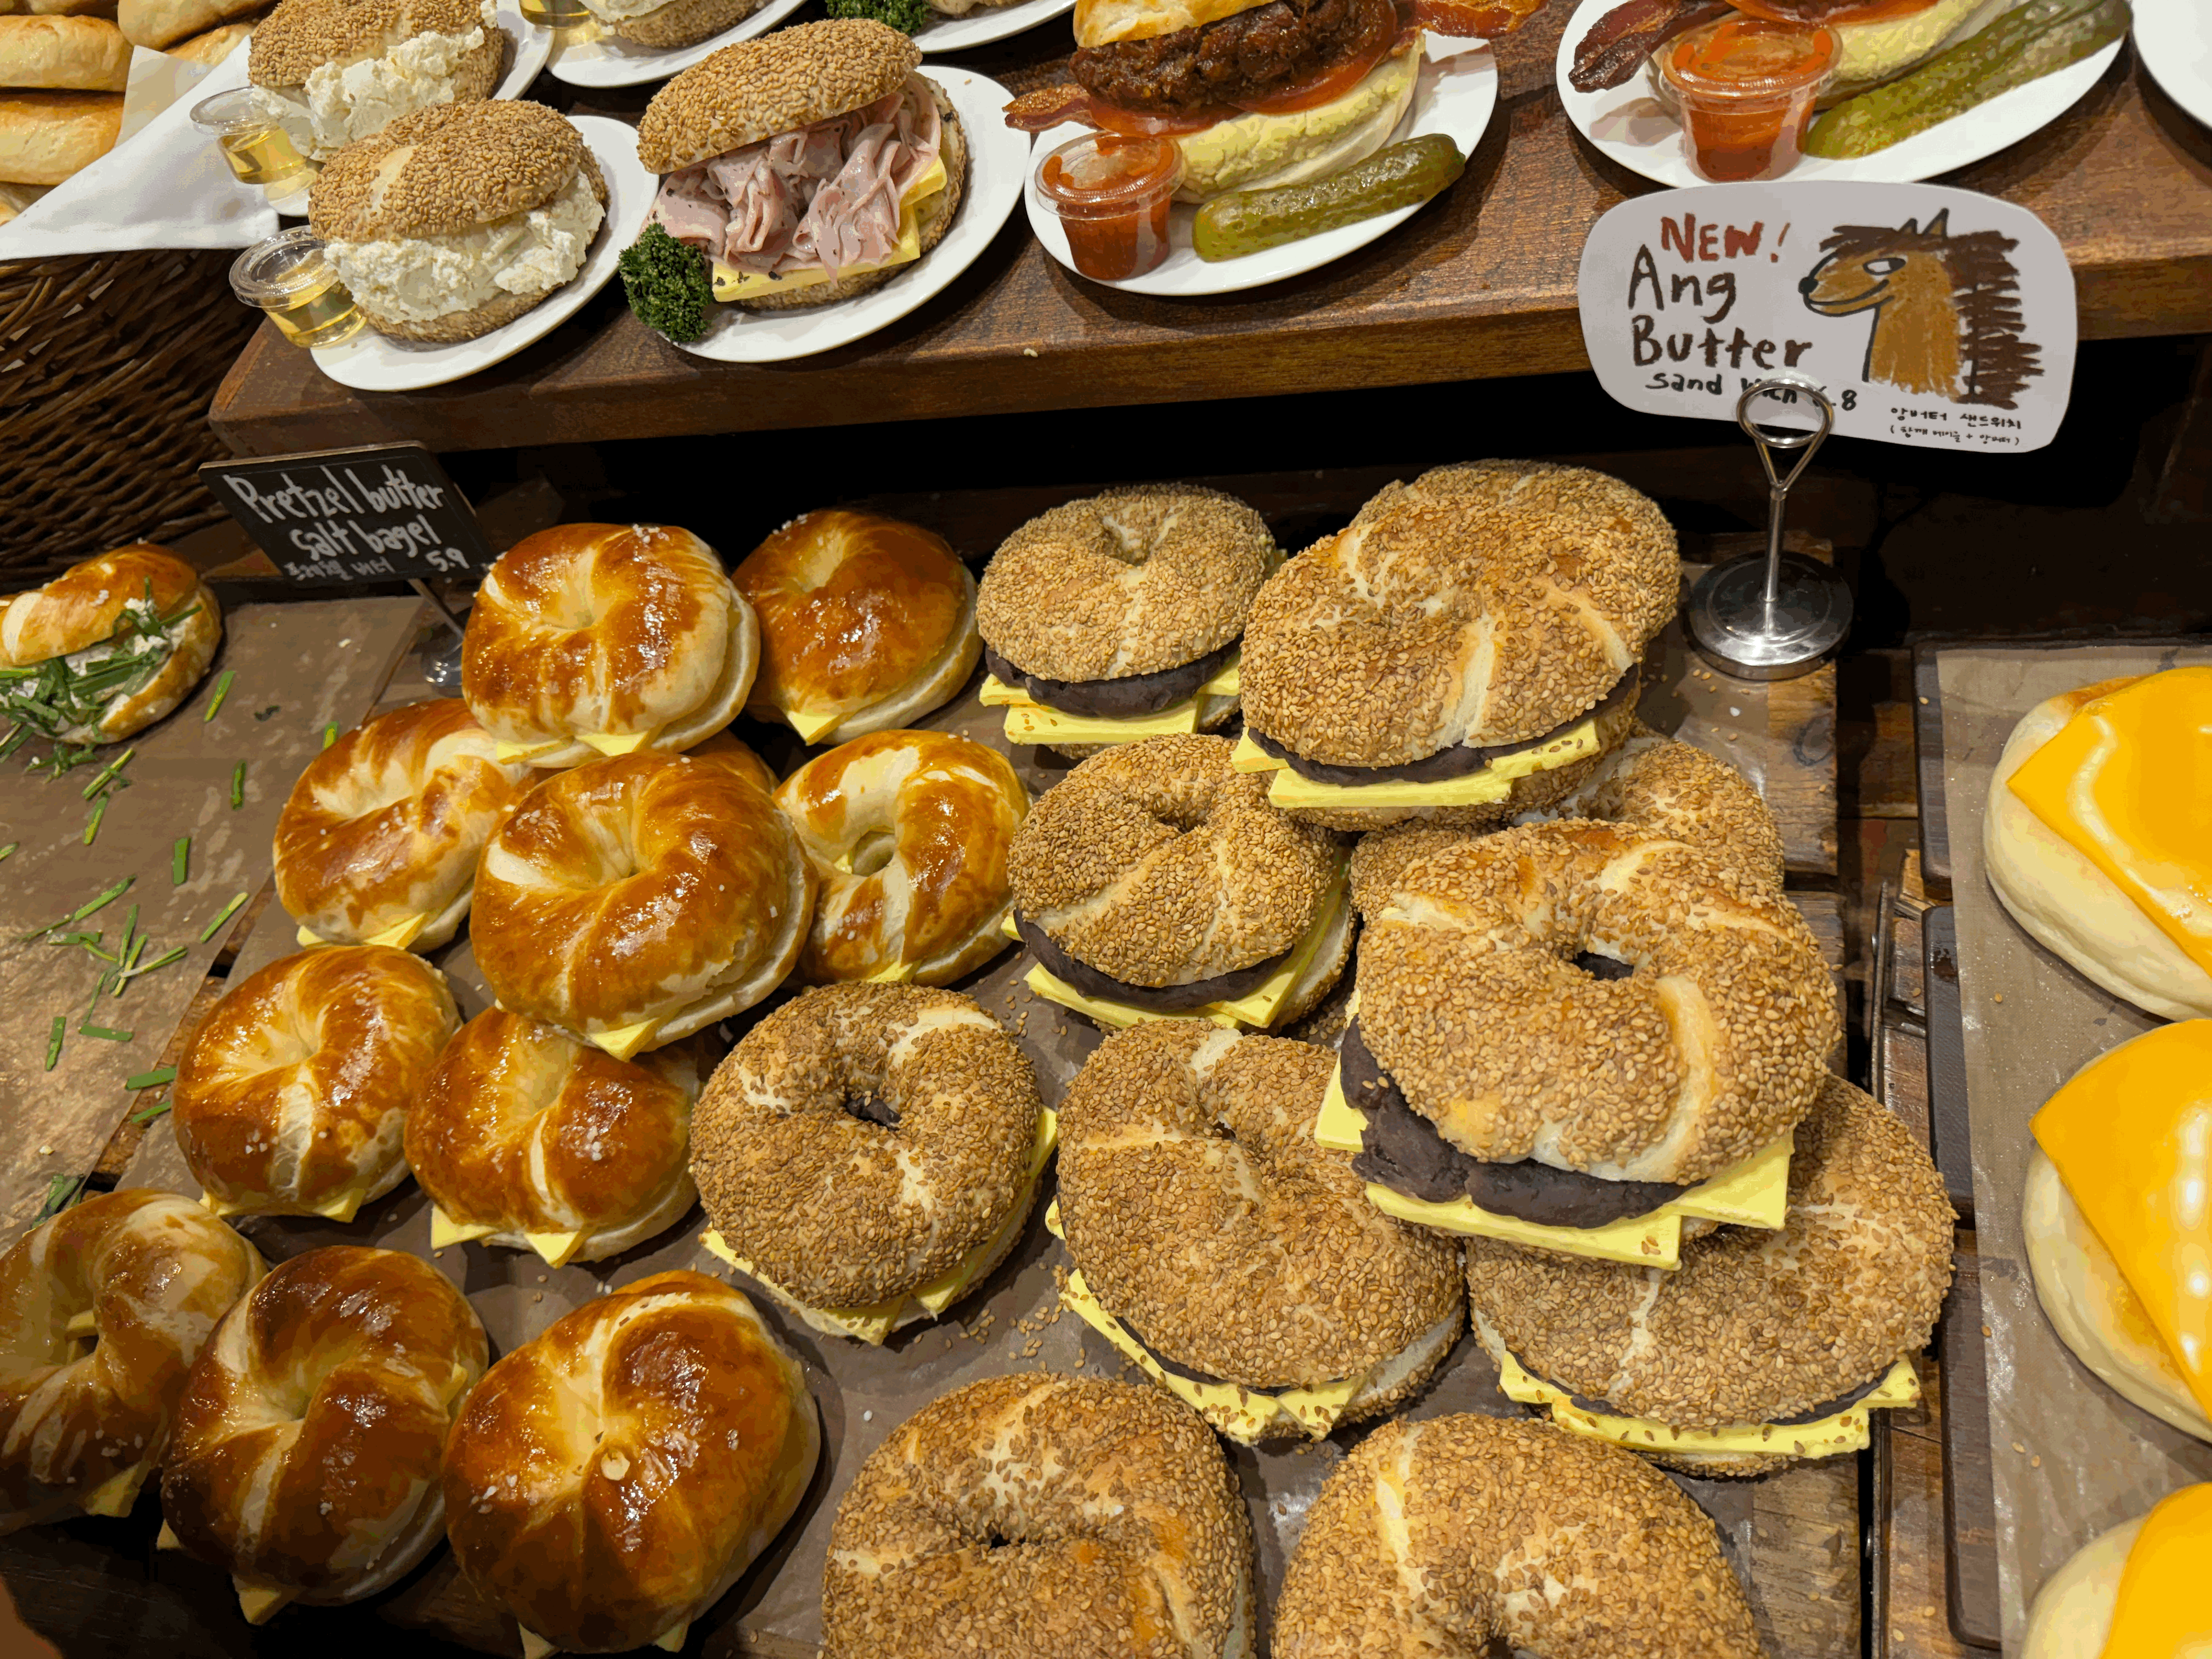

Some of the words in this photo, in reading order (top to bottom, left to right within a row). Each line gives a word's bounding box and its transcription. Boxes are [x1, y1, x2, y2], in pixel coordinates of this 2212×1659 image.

[1660, 212, 1790, 263] NEW!
[1627, 245, 1737, 324] Ang
[1630, 315, 1813, 369] Butter
[1645, 373, 1723, 395] sand
[1891, 407, 1947, 421] 앙버터
[1959, 413, 2022, 430] 샌드위치
[223, 465, 365, 524] Pretzel
[345, 464, 444, 513] butter
[347, 514, 442, 558] bagel
[425, 548, 471, 572] 5.9
